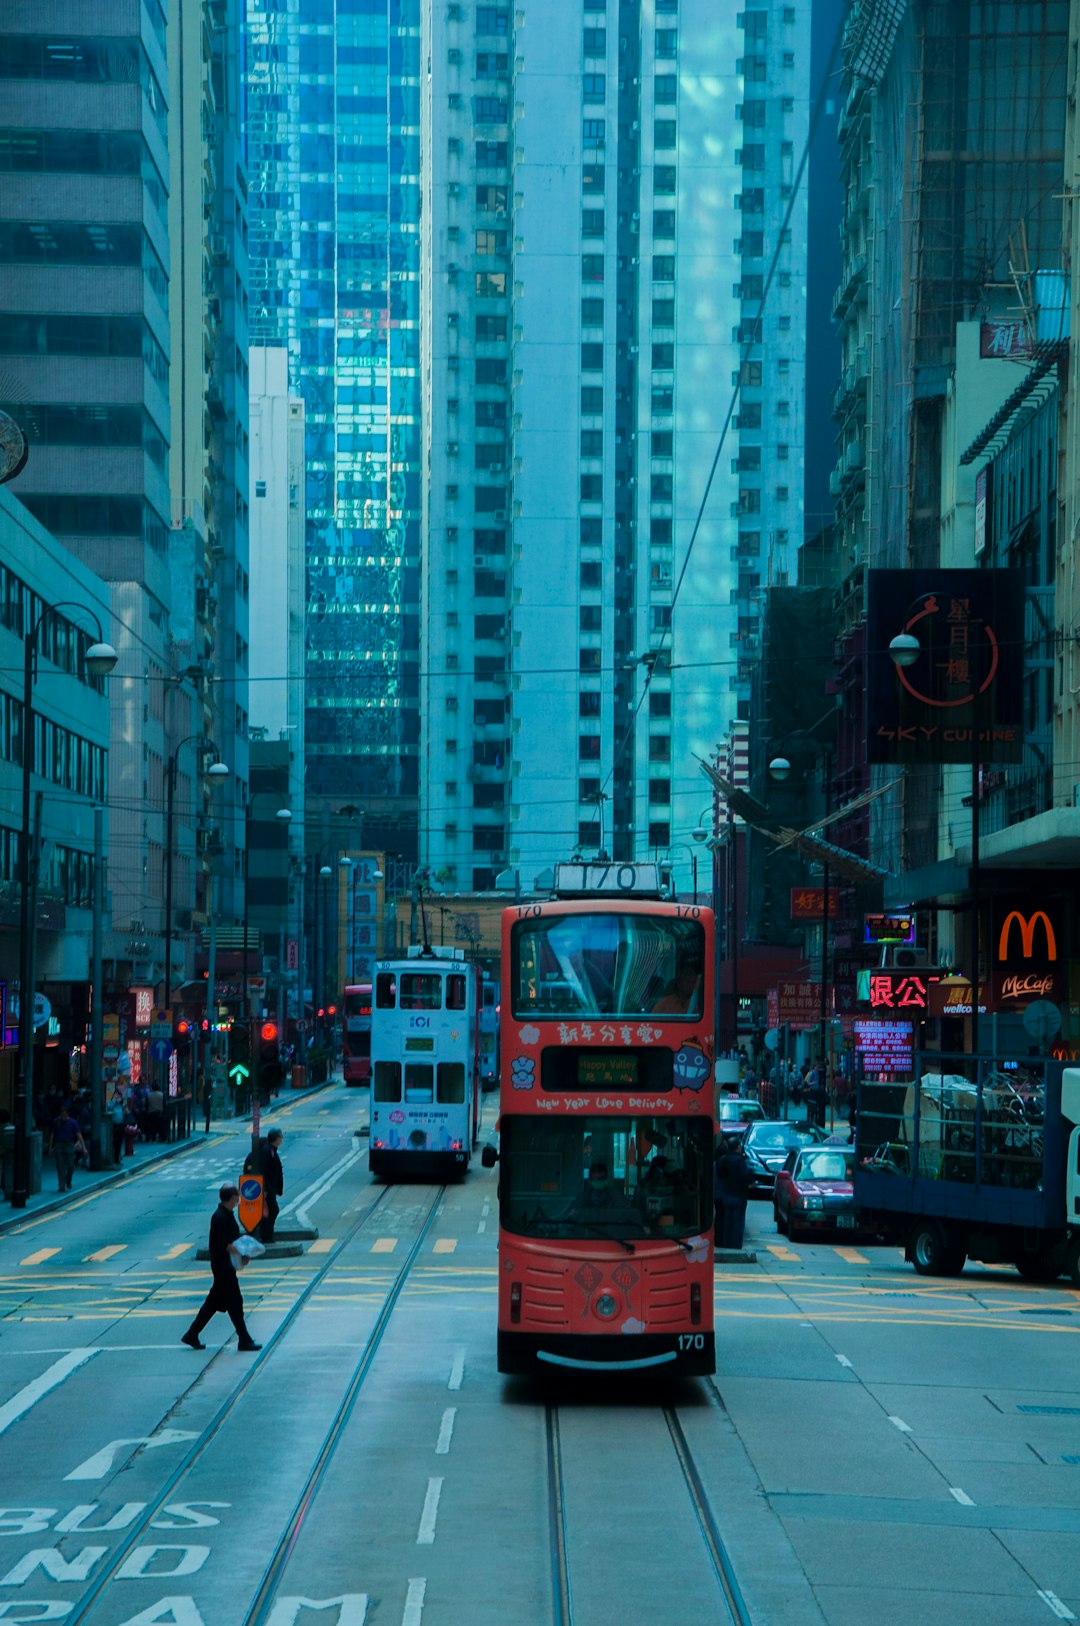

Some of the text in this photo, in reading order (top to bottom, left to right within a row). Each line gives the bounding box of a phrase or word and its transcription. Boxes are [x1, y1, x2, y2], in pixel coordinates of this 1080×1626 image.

[582, 865, 637, 891] 170
[516, 905, 542, 918] 170
[675, 905, 701, 919] 170
[943, 1003, 987, 1014] wellcoe
[536, 1098, 559, 1110] New
[564, 1097, 590, 1110] Year
[629, 1097, 674, 1111] Delivery
[678, 1334, 705, 1350] 170
[0, 1502, 232, 1537] BUS
